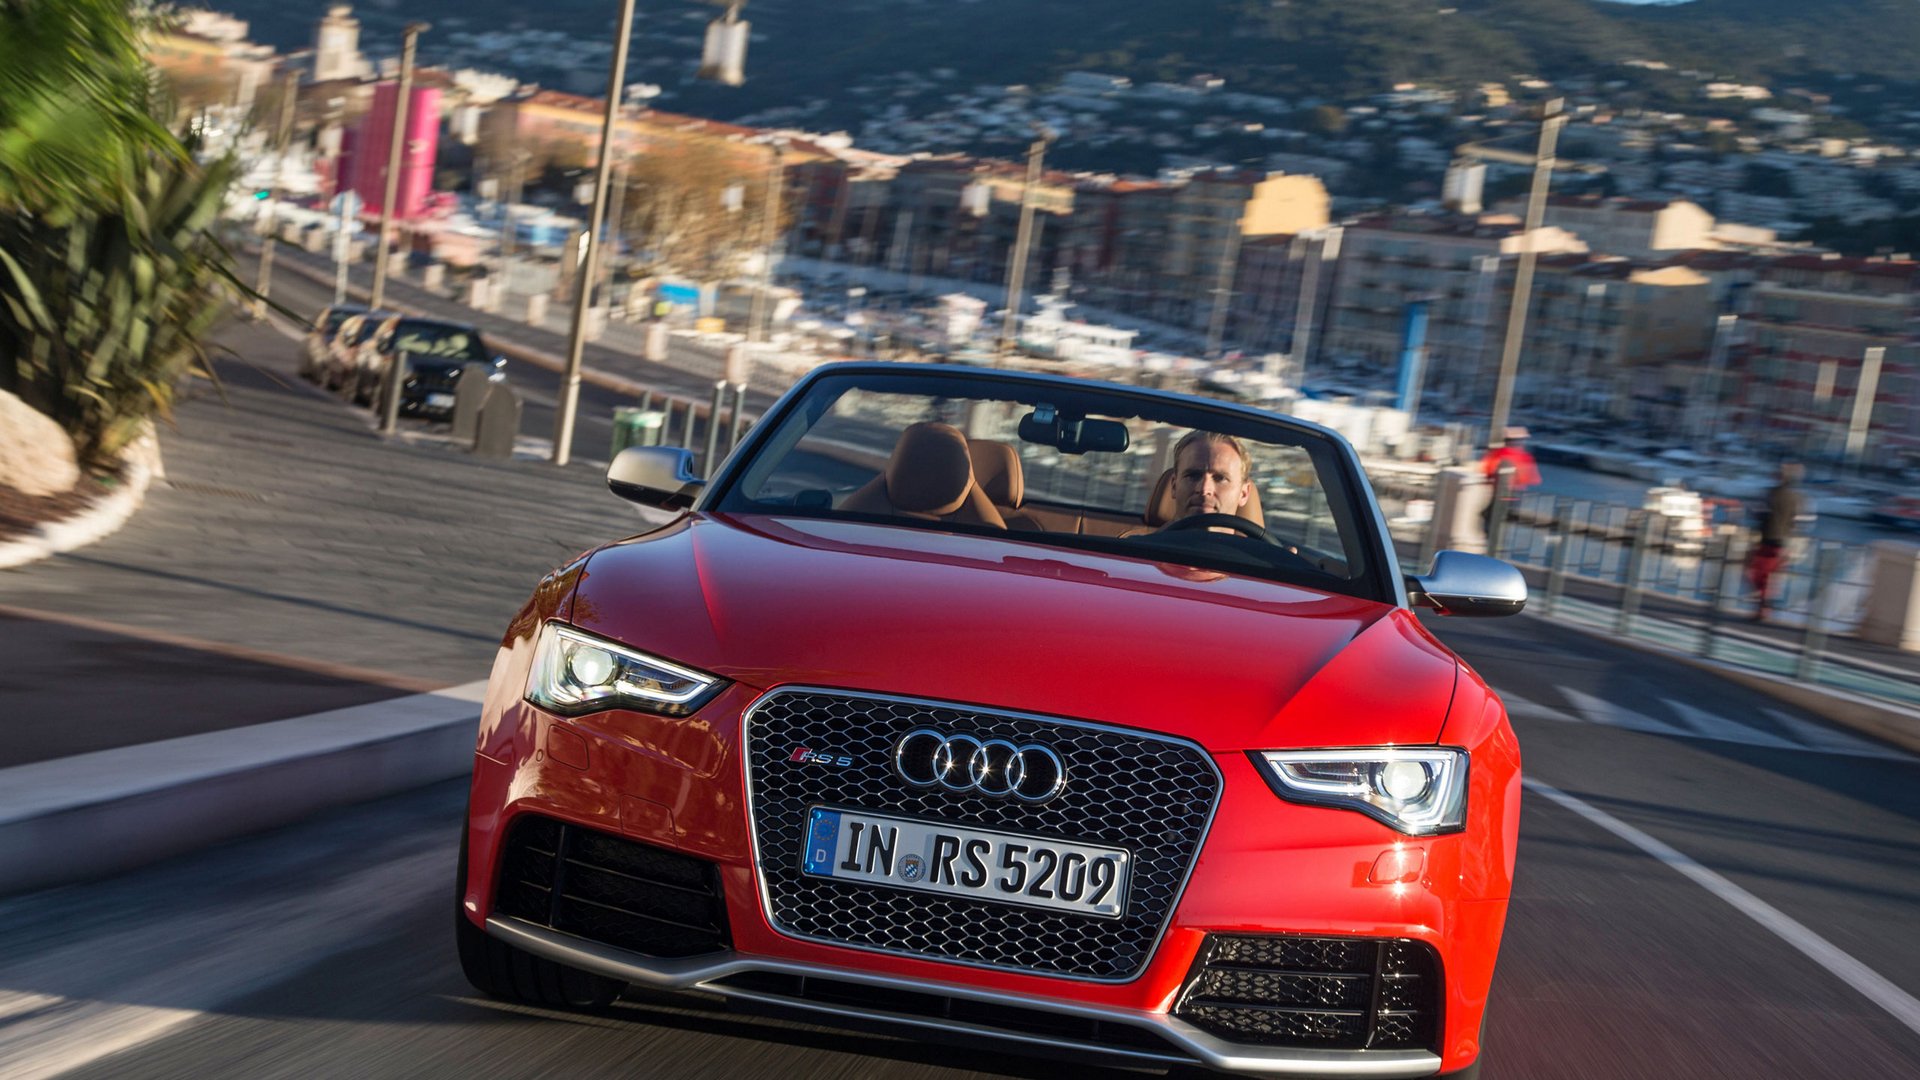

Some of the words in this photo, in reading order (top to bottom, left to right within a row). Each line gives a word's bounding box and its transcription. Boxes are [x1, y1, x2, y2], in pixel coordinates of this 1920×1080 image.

[800, 750, 834, 764] RS
[836, 756, 853, 767] 5
[815, 848, 826, 864] D
[841, 822, 899, 877] IN
[929, 834, 991, 889] RS
[1000, 844, 1116, 906] 5209
